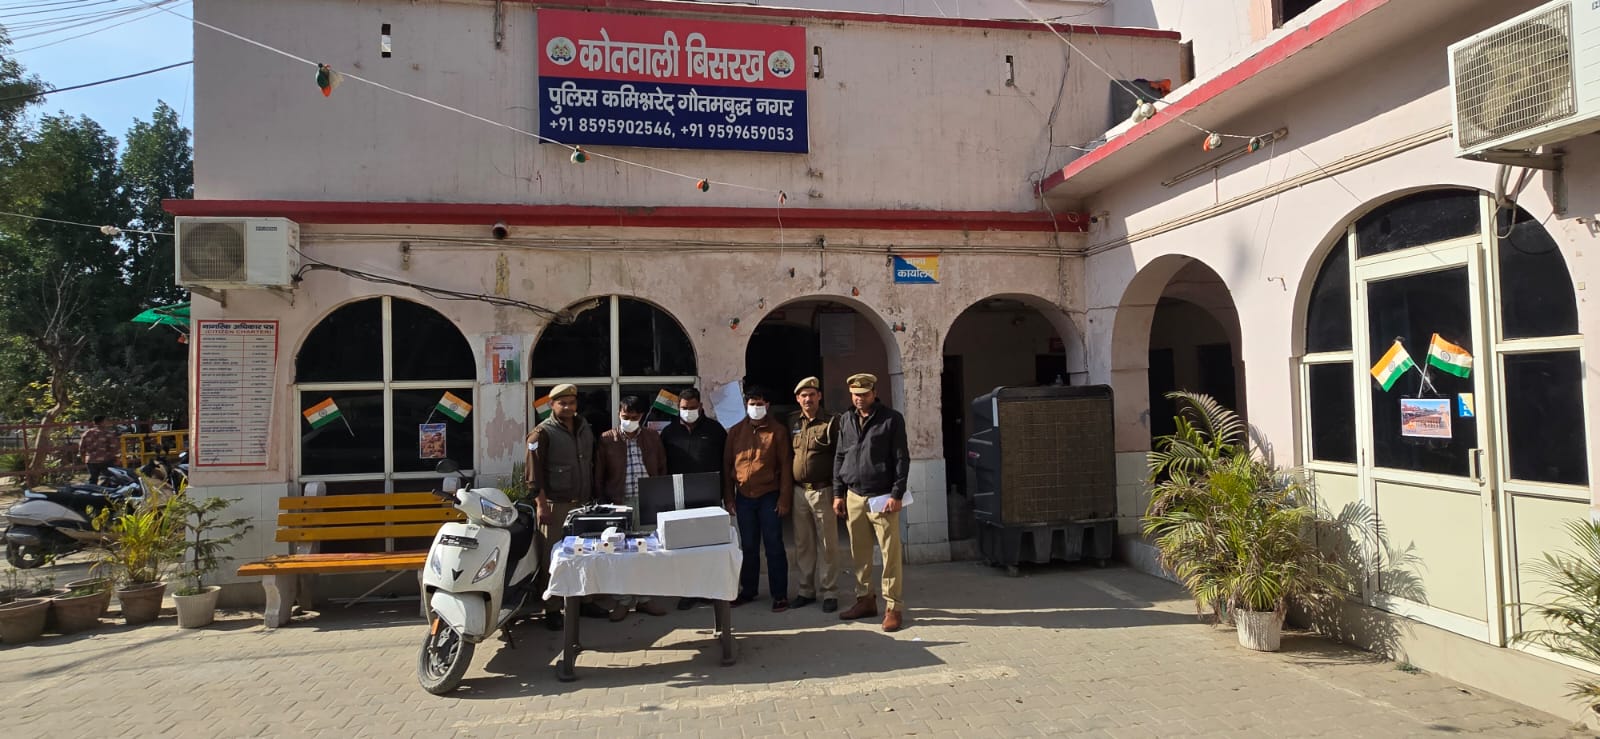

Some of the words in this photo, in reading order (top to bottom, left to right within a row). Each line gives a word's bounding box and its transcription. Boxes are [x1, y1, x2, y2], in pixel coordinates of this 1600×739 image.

[578, 27, 680, 78] कोतवाली
[685, 32, 766, 83] बिसरख
[548, 81, 598, 115] पुलिस
[677, 88, 753, 123] गौतमबुद्ध
[755, 98, 794, 117] नगर
[549, 117, 573, 132] +91
[579, 118, 676, 139] 8595902546,
[680, 123, 703, 138] +91
[708, 124, 794, 141] 9599659053
